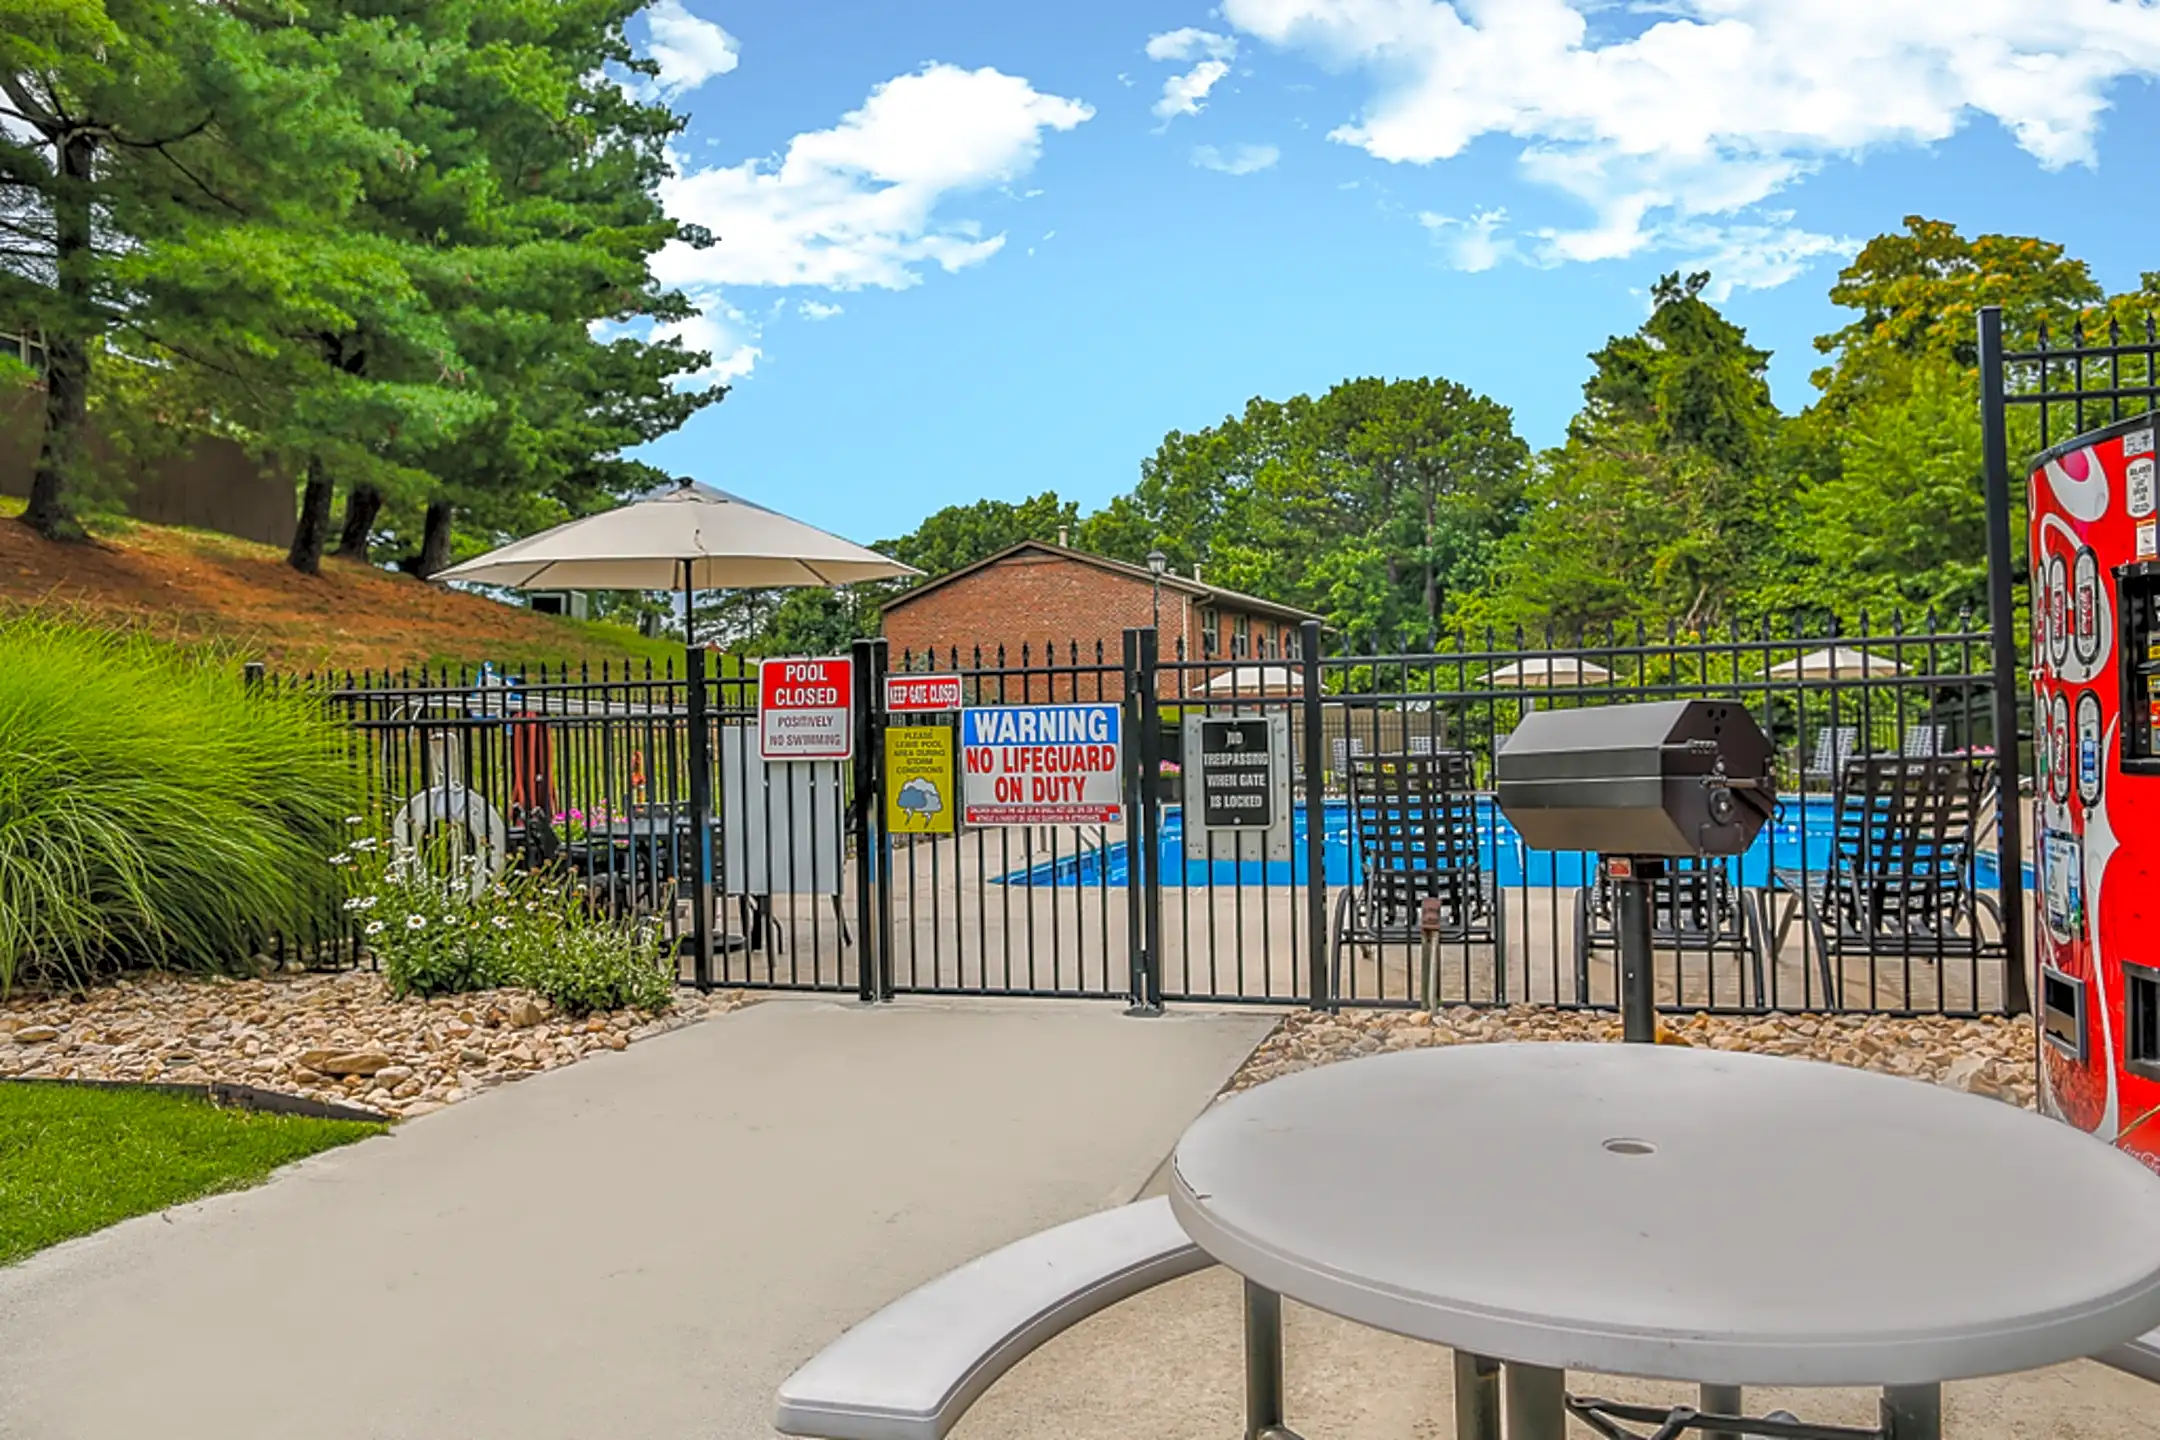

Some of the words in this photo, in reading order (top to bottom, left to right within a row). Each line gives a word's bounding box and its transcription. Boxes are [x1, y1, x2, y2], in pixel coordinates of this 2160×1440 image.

[786, 664, 828, 682] POOL
[775, 687, 837, 706] CLOSED
[930, 683, 957, 703] CLOSED
[777, 715, 834, 728] POSITIVELY
[974, 709, 1108, 744] WARNING
[770, 735, 785, 746] NO
[786, 734, 841, 746] SWIMMING
[1226, 731, 1243, 746] NO
[966, 747, 994, 774] NO
[1003, 745, 1116, 773] LIFEGUARD
[1203, 752, 1268, 766] TRESPASSING
[1206, 774, 1237, 787] WHEN
[1239, 774, 1266, 787] GATE
[995, 776, 1023, 803] ON
[1032, 776, 1087, 803] DUTY
[1210, 795, 1222, 808] IS
[1224, 795, 1262, 808] LOCKED
